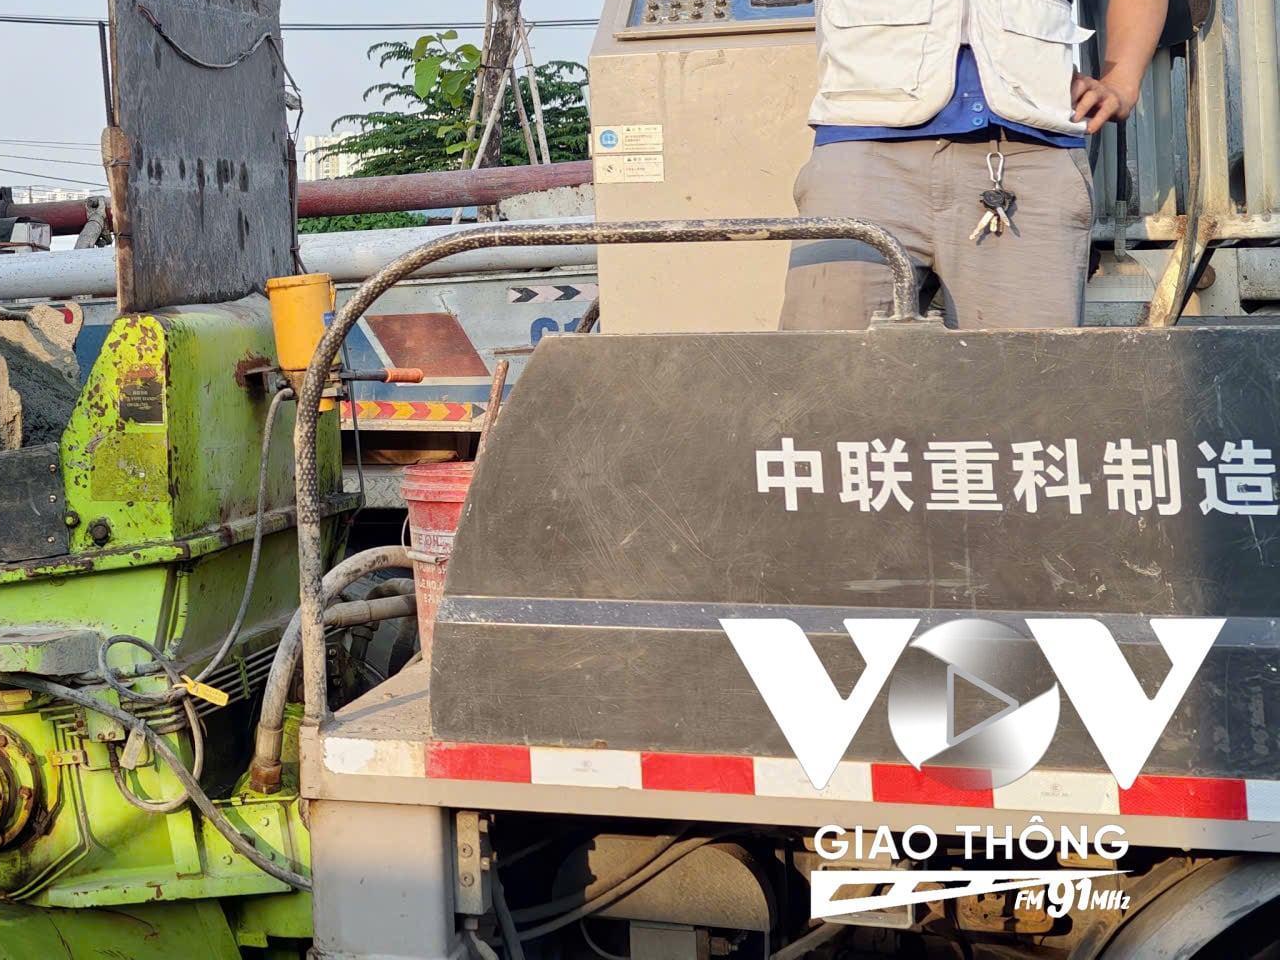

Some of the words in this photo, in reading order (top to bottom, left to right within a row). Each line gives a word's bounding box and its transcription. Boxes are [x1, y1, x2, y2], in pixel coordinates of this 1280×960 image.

[755, 437, 1279, 515] 中联重科制造
